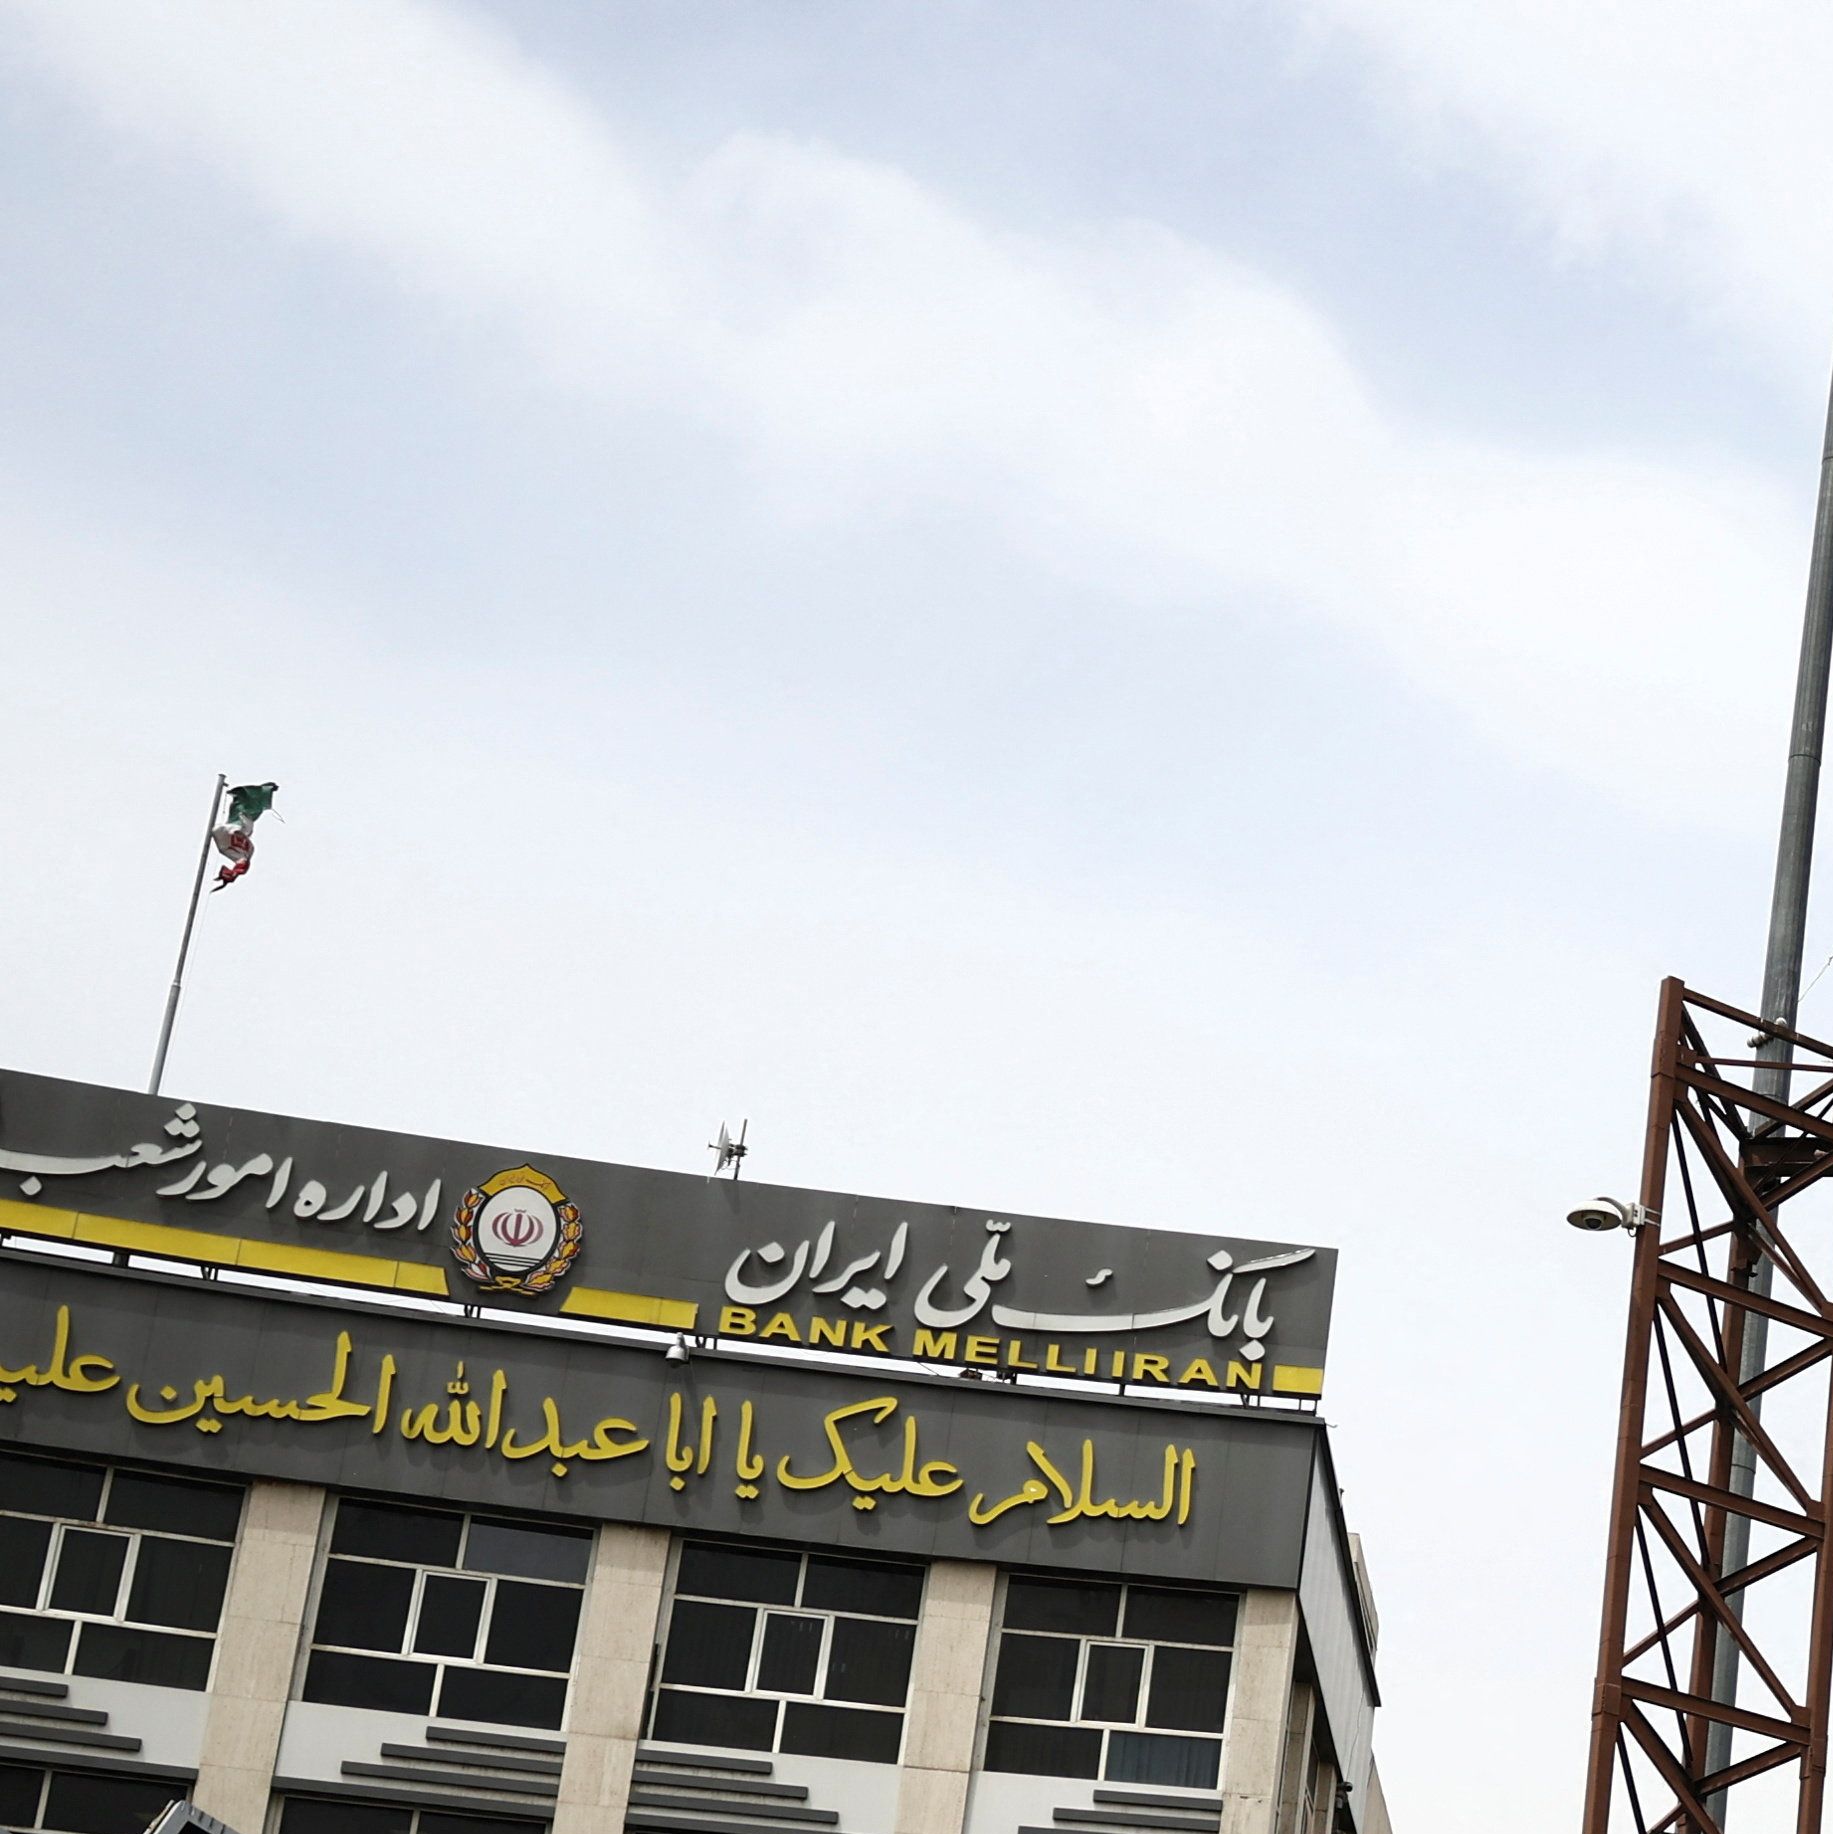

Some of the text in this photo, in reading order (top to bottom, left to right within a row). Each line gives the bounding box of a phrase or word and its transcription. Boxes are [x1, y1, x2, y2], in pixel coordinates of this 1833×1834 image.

[155, 1153, 294, 1209] امور
[293, 1170, 442, 1230] اداره
[724, 1220, 909, 1310] ایران
[991, 1248, 1317, 1361] بانک
[126, 1329, 396, 1433] الحسین
[718, 1306, 1263, 1391] BANK MELLI IRAN
[735, 1400, 765, 1500] یا
[777, 1396, 963, 1510] علیک
[968, 1438, 1196, 1527] السلام
